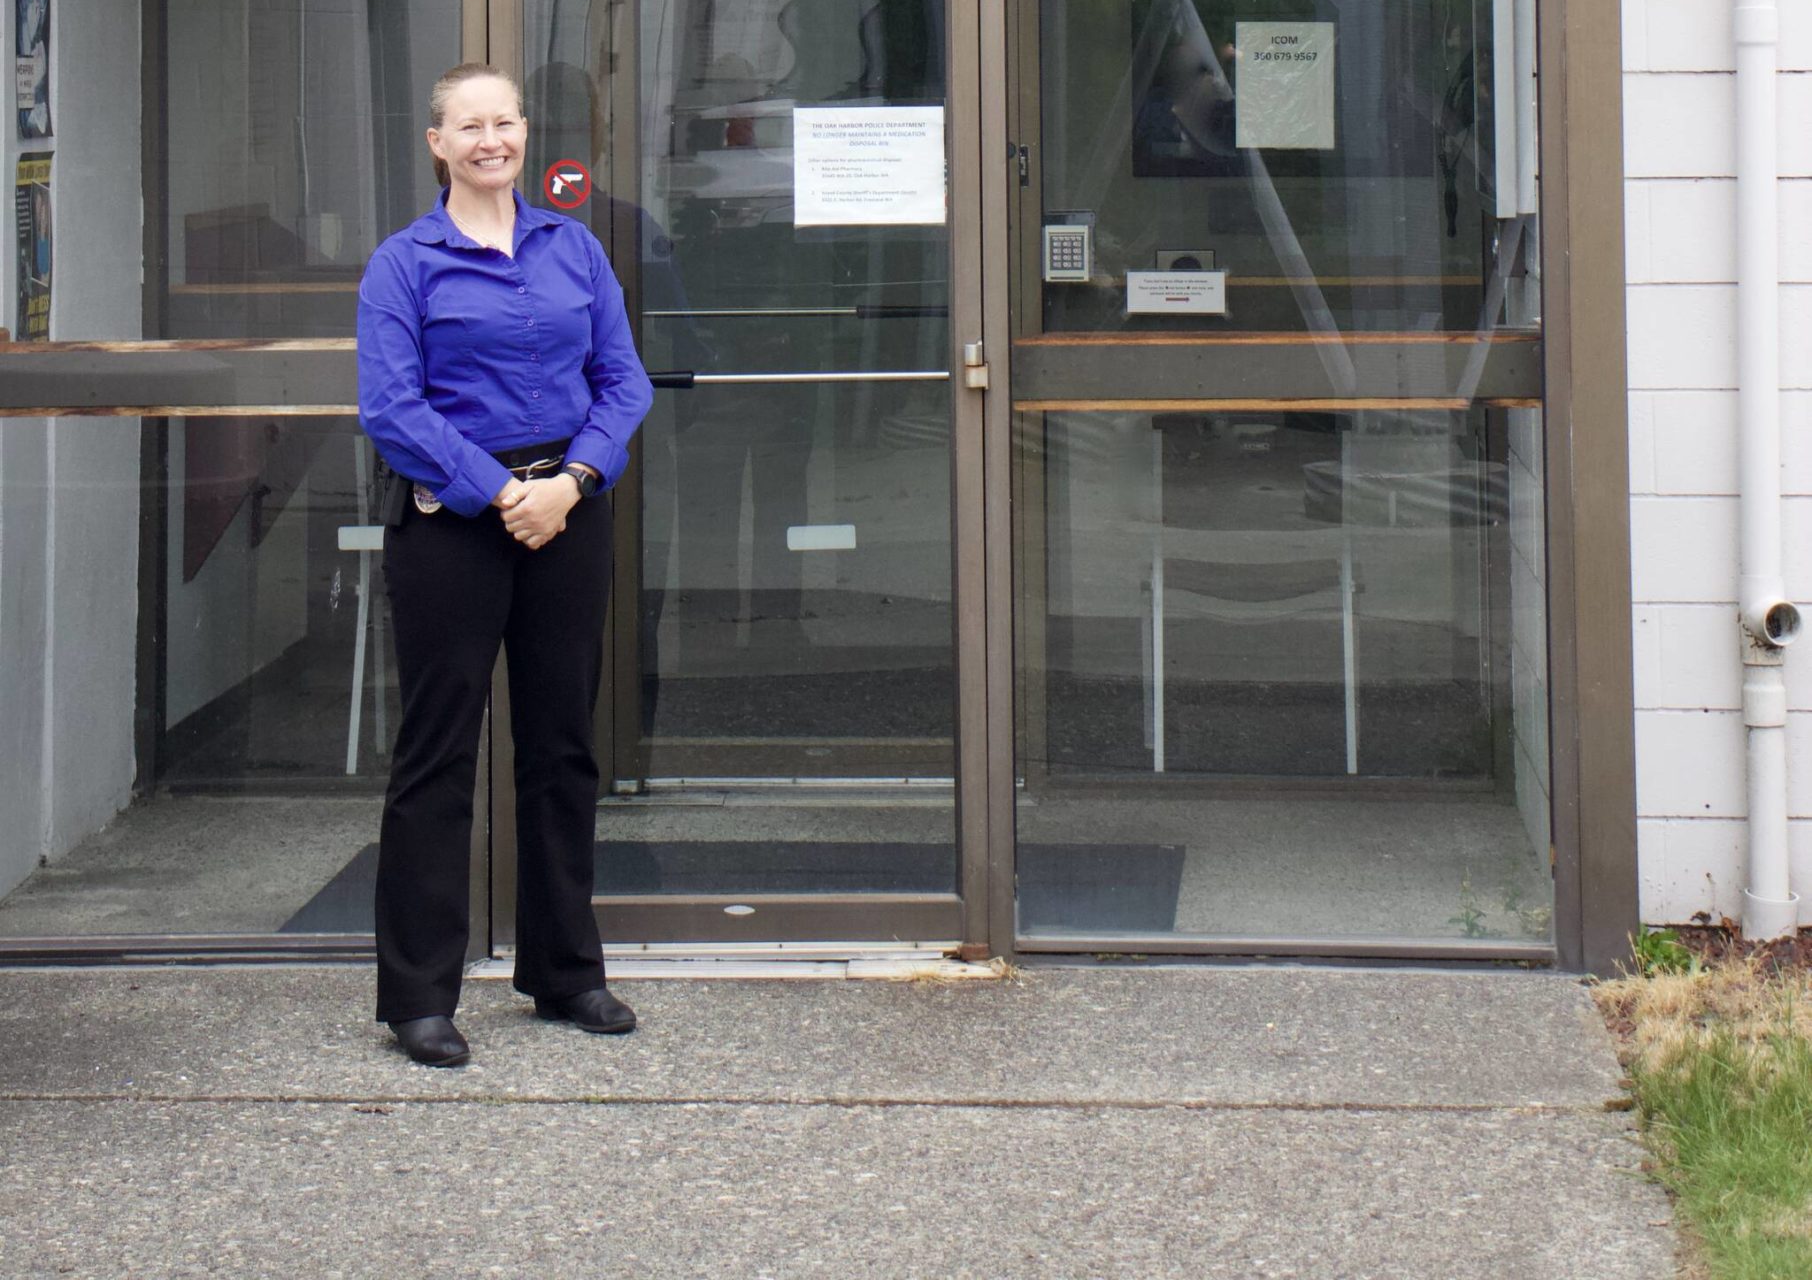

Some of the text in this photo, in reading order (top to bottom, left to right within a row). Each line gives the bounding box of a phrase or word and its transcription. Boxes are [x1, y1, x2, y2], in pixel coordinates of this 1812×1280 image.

[1271, 35, 1299, 45] ICOM
[1273, 51, 1292, 61] 679
[1294, 51, 1318, 61] 9567
[888, 130, 926, 138] MEDICATION
